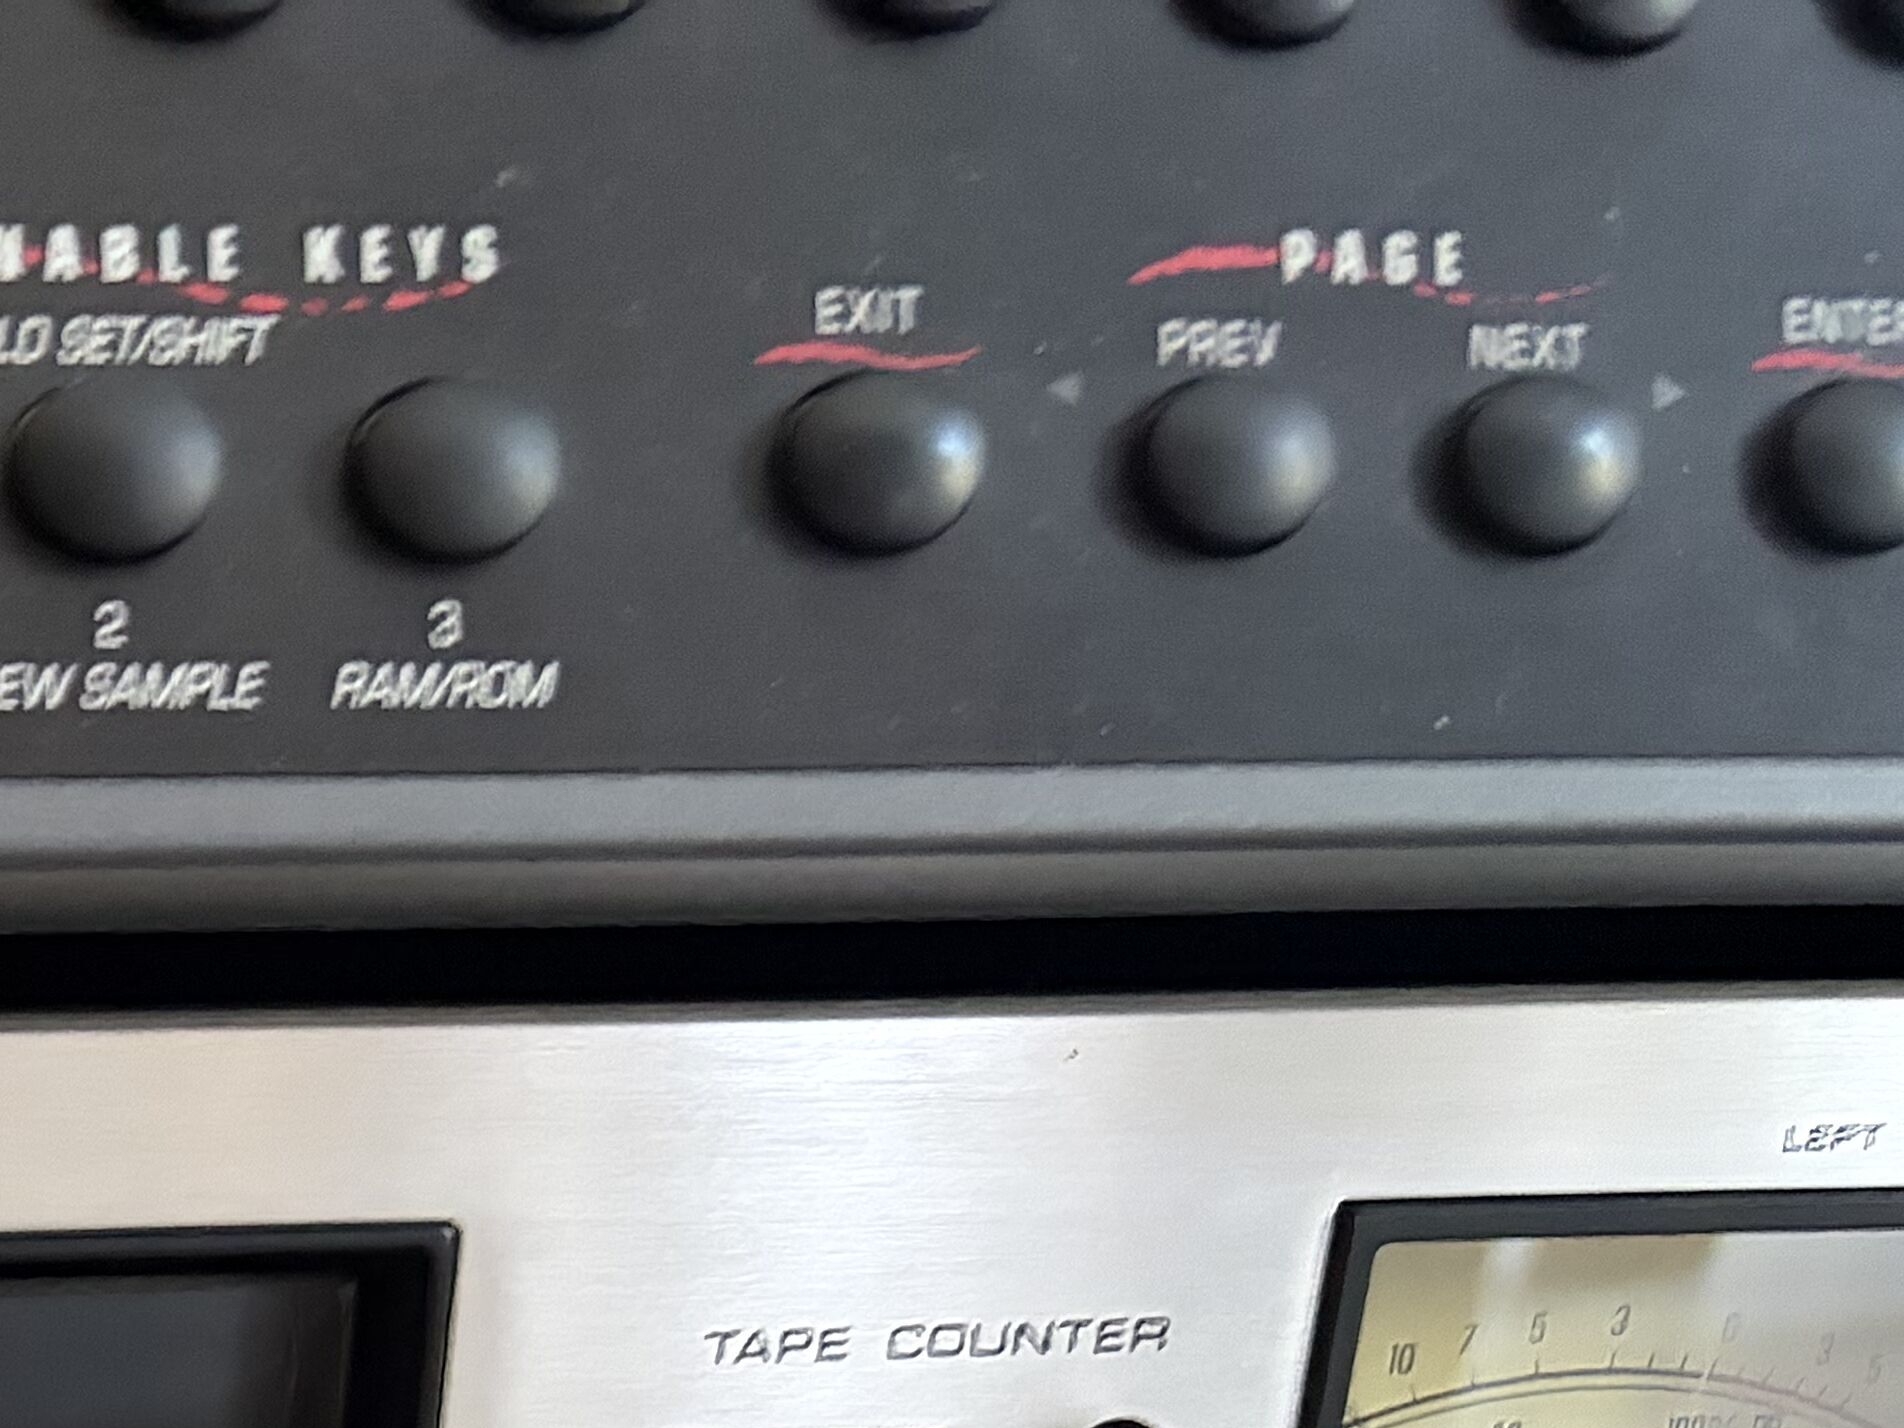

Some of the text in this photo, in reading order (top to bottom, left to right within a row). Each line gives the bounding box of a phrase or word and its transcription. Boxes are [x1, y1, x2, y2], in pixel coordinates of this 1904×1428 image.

[300, 224, 504, 284] KEYS
[1278, 229, 1467, 286] PAGE
[814, 286, 926, 338] EXIT
[52, 314, 282, 368] SET/SHIFT
[1156, 320, 1283, 367] PREV
[1468, 322, 1590, 370] NEXT
[92, 602, 128, 649] 2
[426, 602, 464, 649] 3
[78, 662, 270, 712] SAMPLE
[330, 662, 560, 712] RAM/ROM
[702, 1316, 1172, 1368] TAPE COUNTER
[1390, 1342, 1418, 1376] 10
[1610, 1304, 1632, 1338] 3
